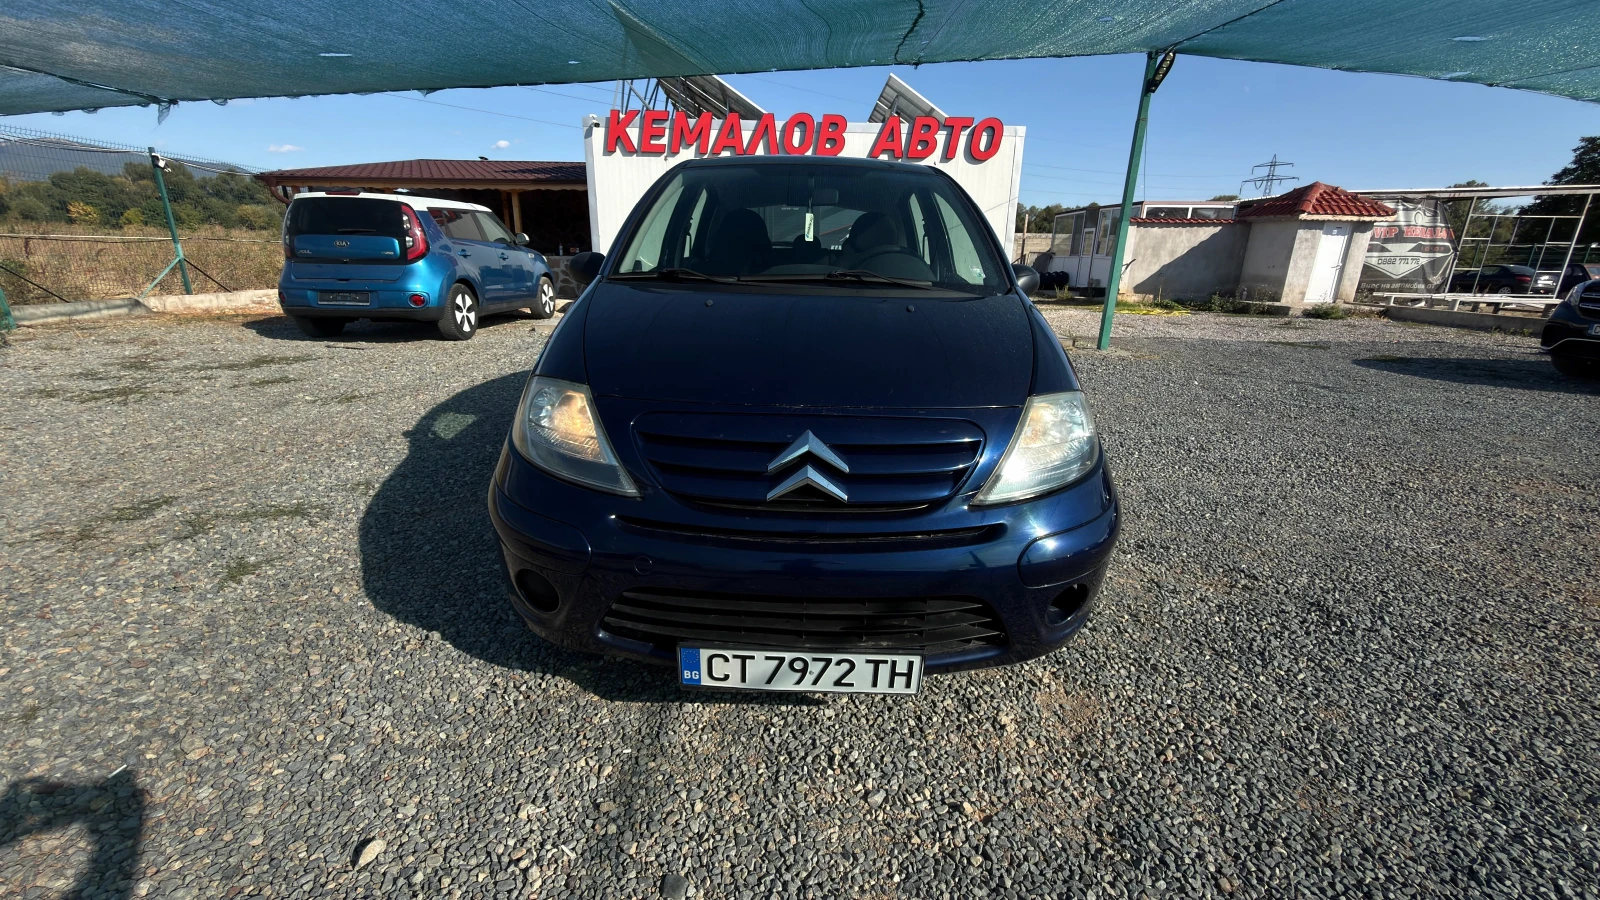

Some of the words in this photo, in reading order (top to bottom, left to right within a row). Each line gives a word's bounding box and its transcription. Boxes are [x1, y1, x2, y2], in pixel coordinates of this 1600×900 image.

[606, 109, 849, 157] КЕМАЛОВ
[870, 115, 1005, 162] АВТО
[1373, 227, 1398, 238] VIP
[683, 670, 700, 680] BG
[707, 653, 756, 684] CT
[764, 655, 857, 688] 7972
[864, 658, 915, 689] TH
